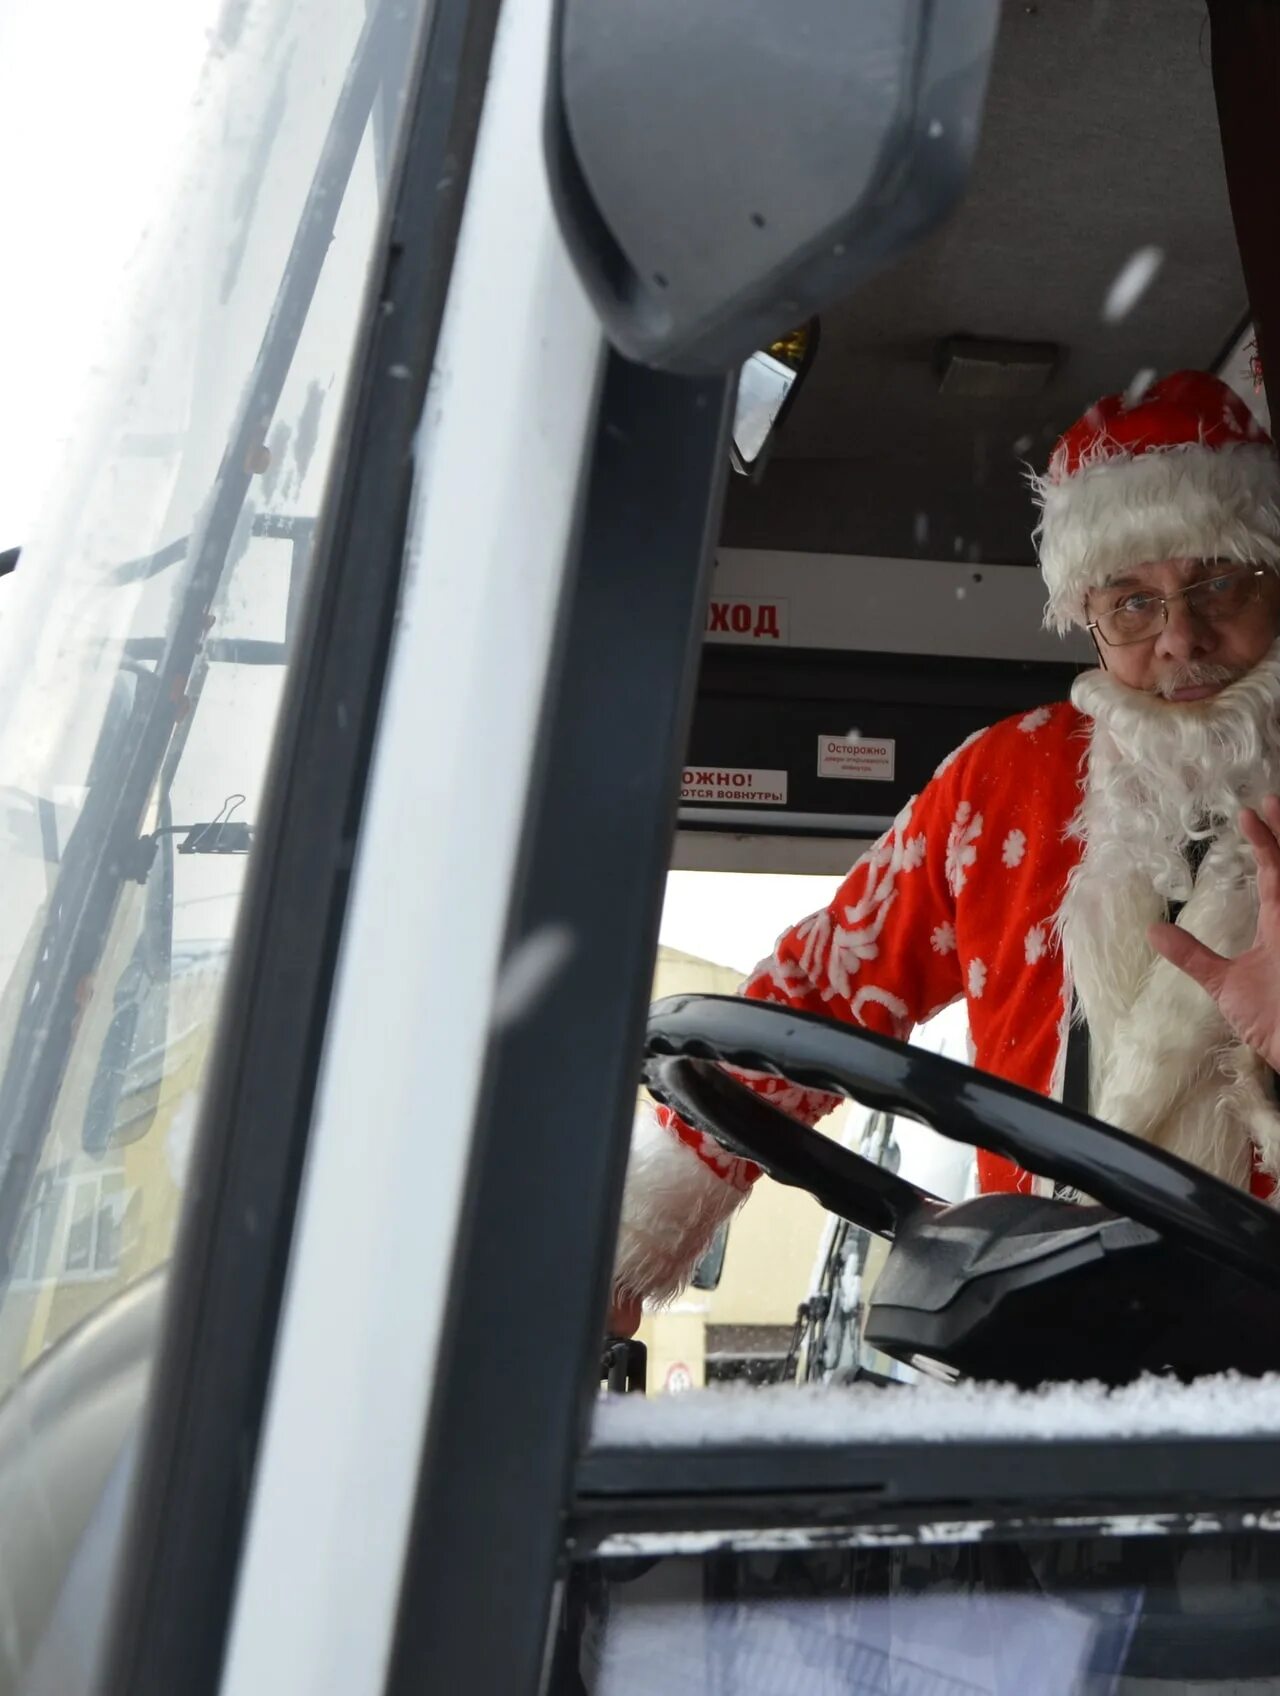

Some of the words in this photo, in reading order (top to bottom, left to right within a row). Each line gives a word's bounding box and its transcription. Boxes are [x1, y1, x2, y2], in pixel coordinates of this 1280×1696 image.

[704, 602, 780, 639] ХОД
[827, 742, 887, 756] Осторожно
[681, 771, 753, 787] ОЖНО!
[717, 790, 783, 801] ВОВНУТРЬ!
